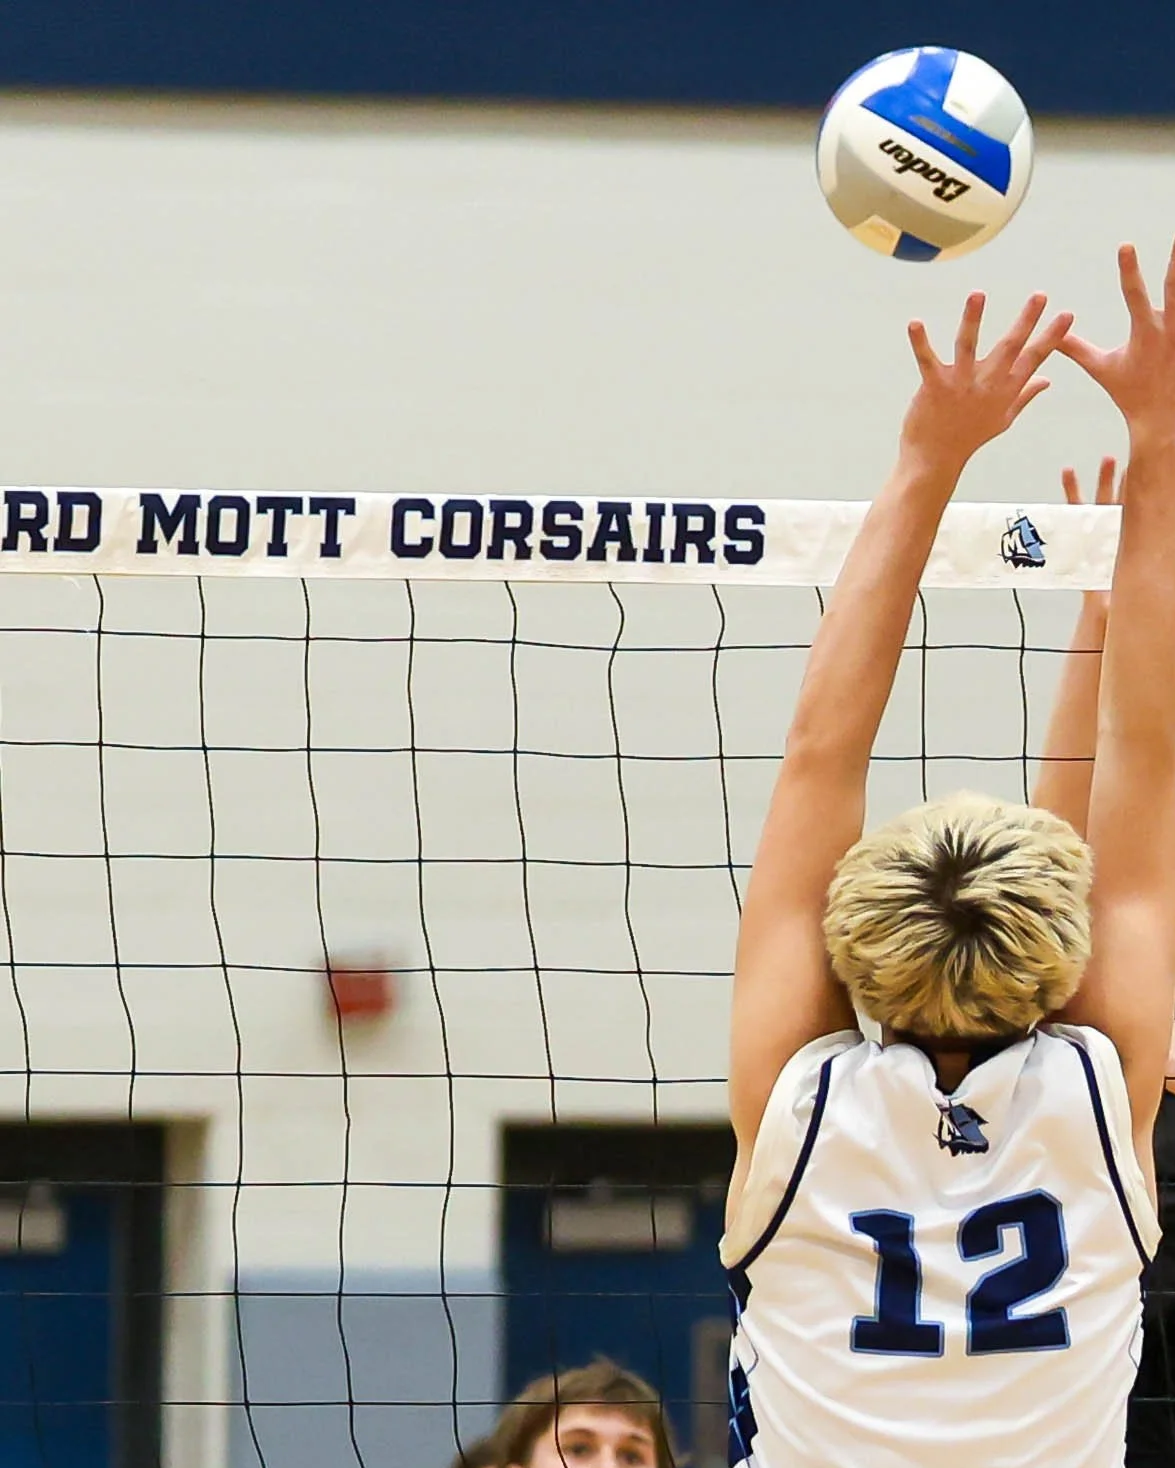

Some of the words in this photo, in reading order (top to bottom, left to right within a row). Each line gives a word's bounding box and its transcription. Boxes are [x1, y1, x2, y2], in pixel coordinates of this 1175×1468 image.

[878, 138, 971, 203] Baden
[1, 490, 103, 553] RD
[135, 493, 356, 558] MOTT
[390, 498, 766, 565] CORSAIRS
[848, 1187, 1071, 1357] 12
